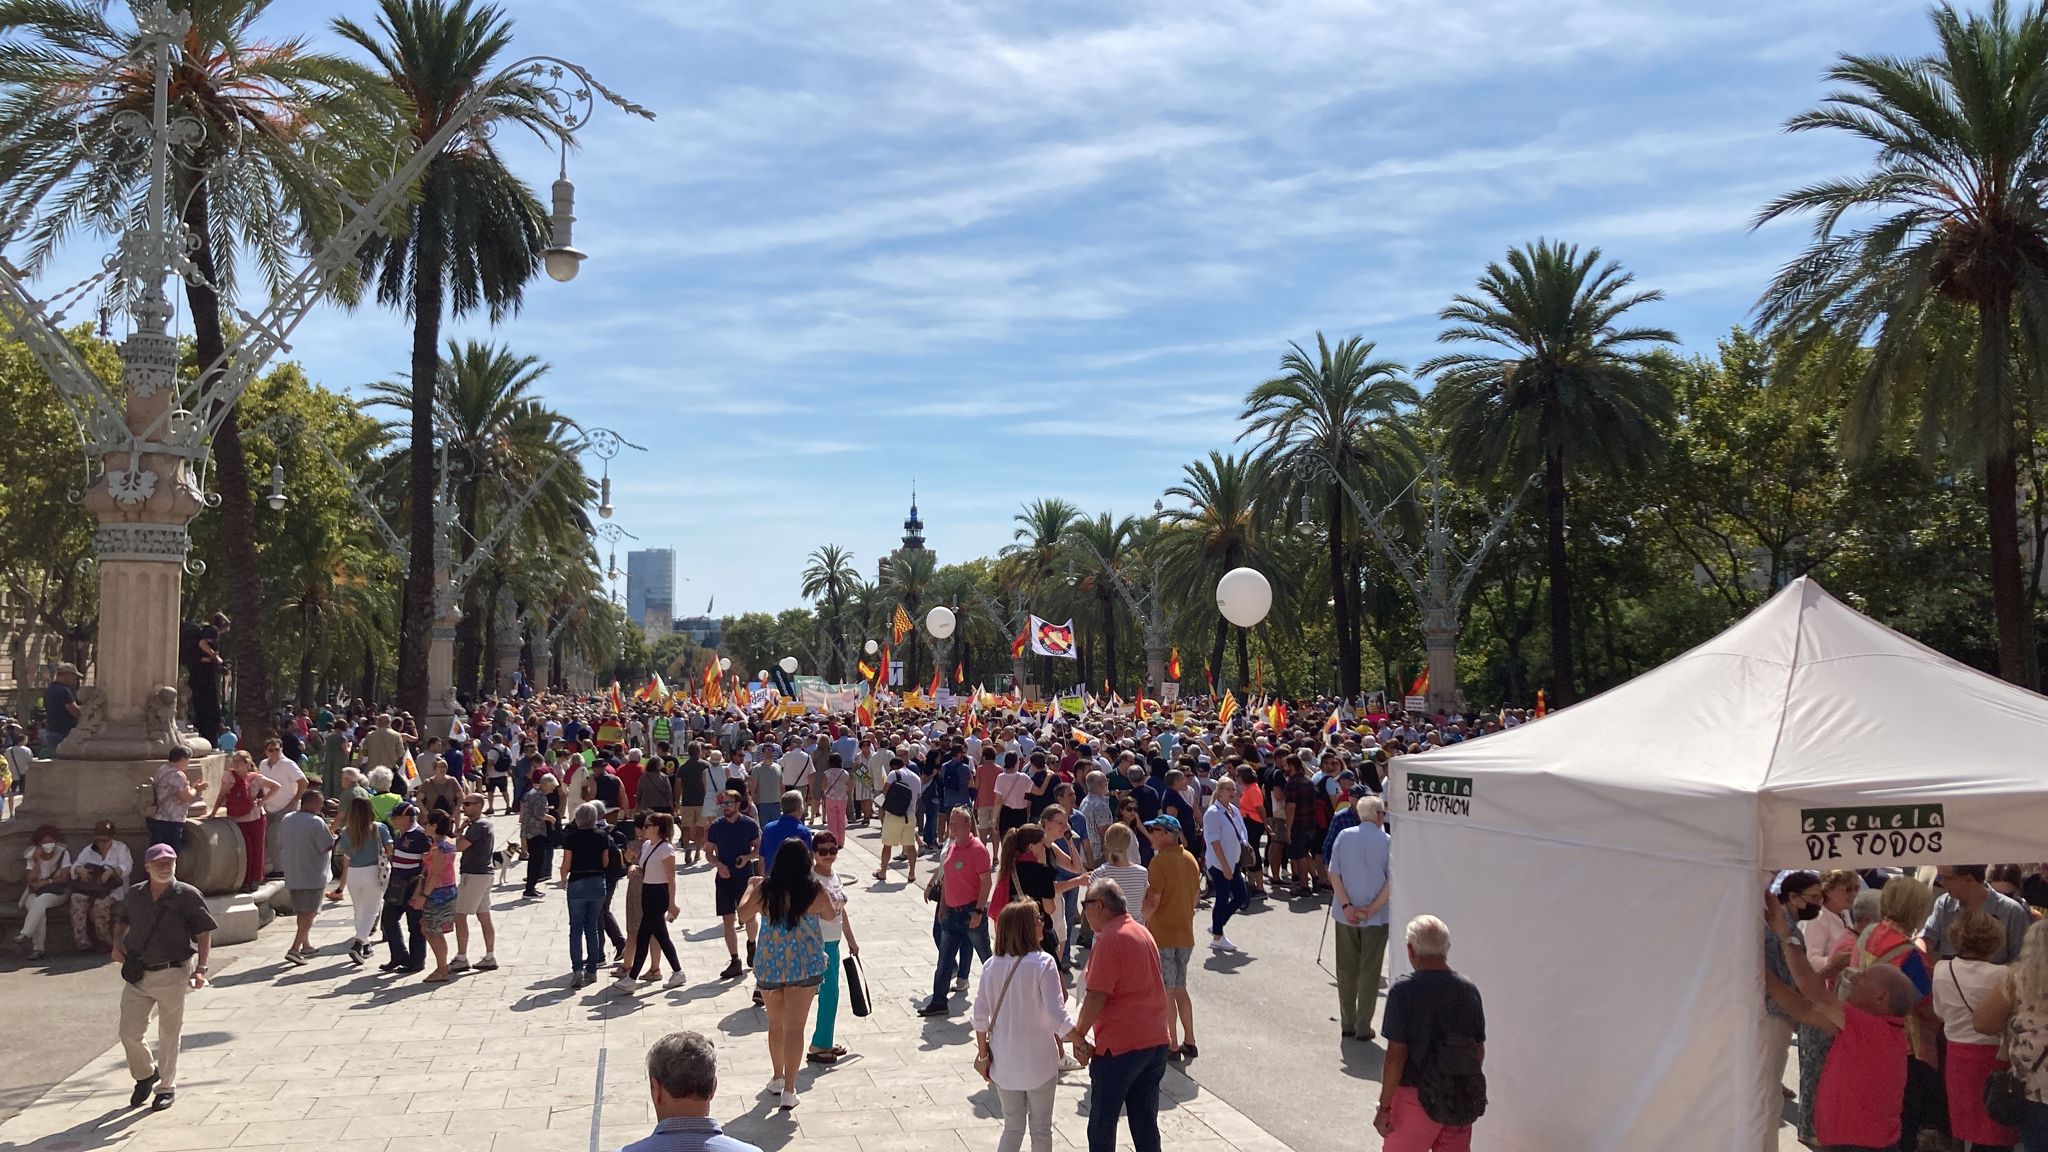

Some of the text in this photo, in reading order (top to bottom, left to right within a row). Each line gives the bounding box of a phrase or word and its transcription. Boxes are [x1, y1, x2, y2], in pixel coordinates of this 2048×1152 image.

[1424, 794, 1470, 817] TOTHOM
[1804, 807, 1943, 832] escuela
[1805, 830, 1943, 861] DE TODOS
